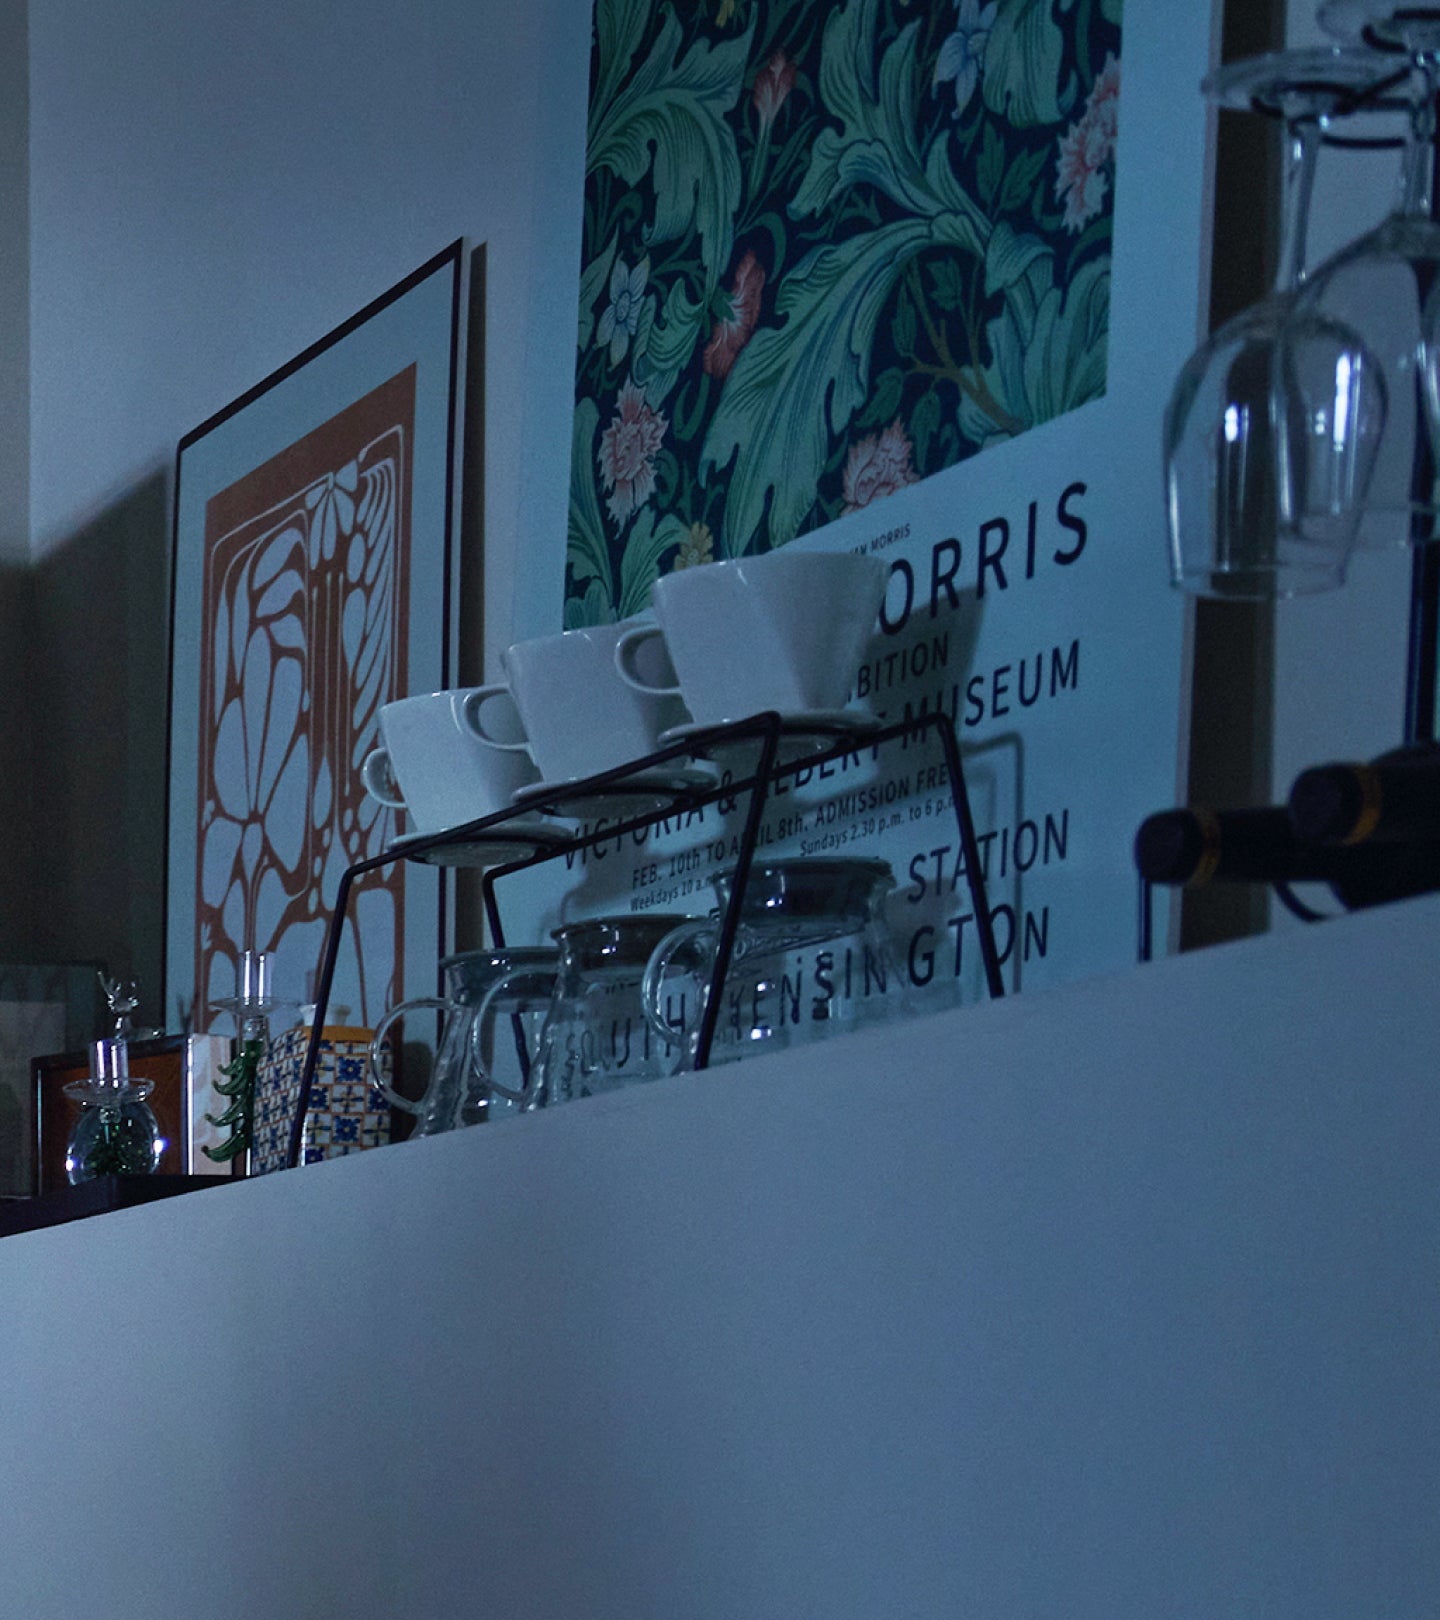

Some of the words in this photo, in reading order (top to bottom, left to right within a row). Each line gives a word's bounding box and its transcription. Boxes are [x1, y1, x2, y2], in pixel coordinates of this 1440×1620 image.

[870, 522, 911, 552] MORRIS
[880, 482, 1087, 636] ORRIS
[847, 631, 949, 703] BITION
[633, 864, 662, 891] FEB.
[669, 848, 700, 877] 10th
[706, 841, 725, 864] TO
[730, 824, 773, 856] AIL
[815, 776, 910, 828] ADMISSION
[916, 762, 948, 794] FRE
[800, 829, 848, 857] Sundays
[850, 817, 876, 840] 2.30
[878, 812, 904, 835] p.m.
[909, 806, 922, 821] to
[926, 798, 932, 815] 6
[907, 808, 1069, 903] STATION
[630, 886, 679, 912] Weekdays
[682, 880, 693, 897] 10
